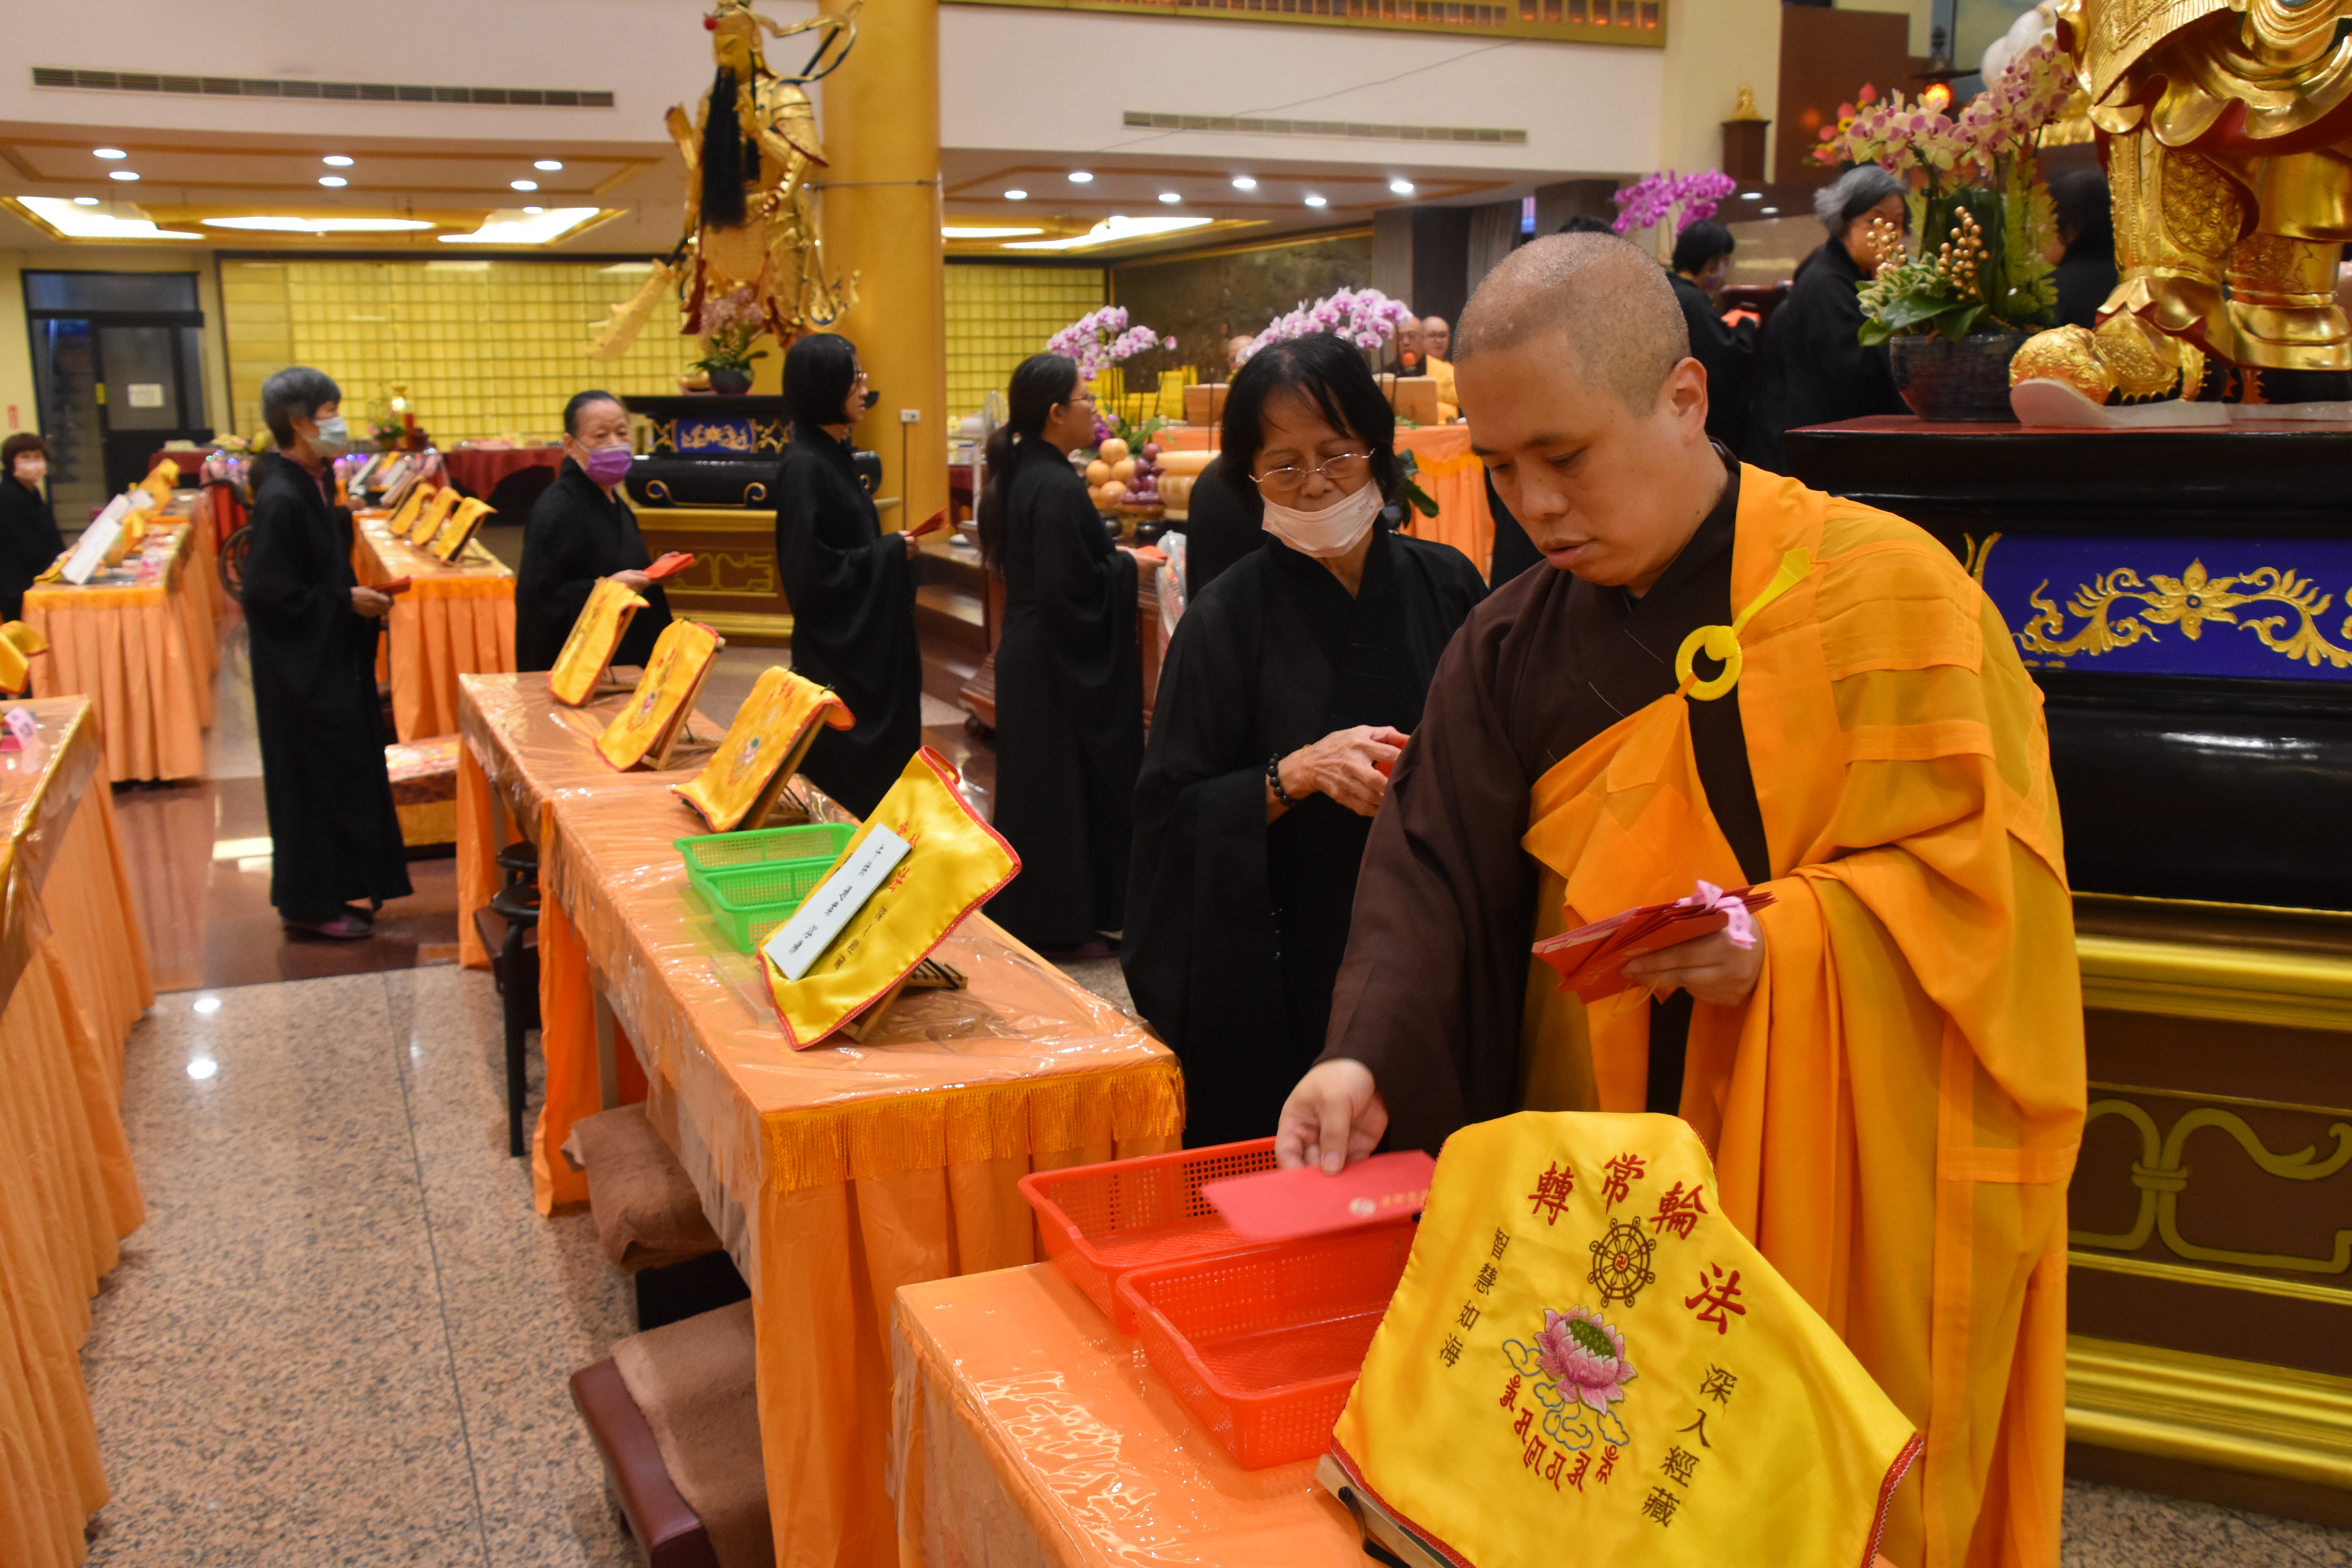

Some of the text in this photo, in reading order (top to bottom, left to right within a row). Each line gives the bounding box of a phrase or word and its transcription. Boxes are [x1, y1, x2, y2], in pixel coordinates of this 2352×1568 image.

[1439, 1227, 1510, 1368] 智慧如海
[1641, 1362, 1737, 1528] 深入經藏
